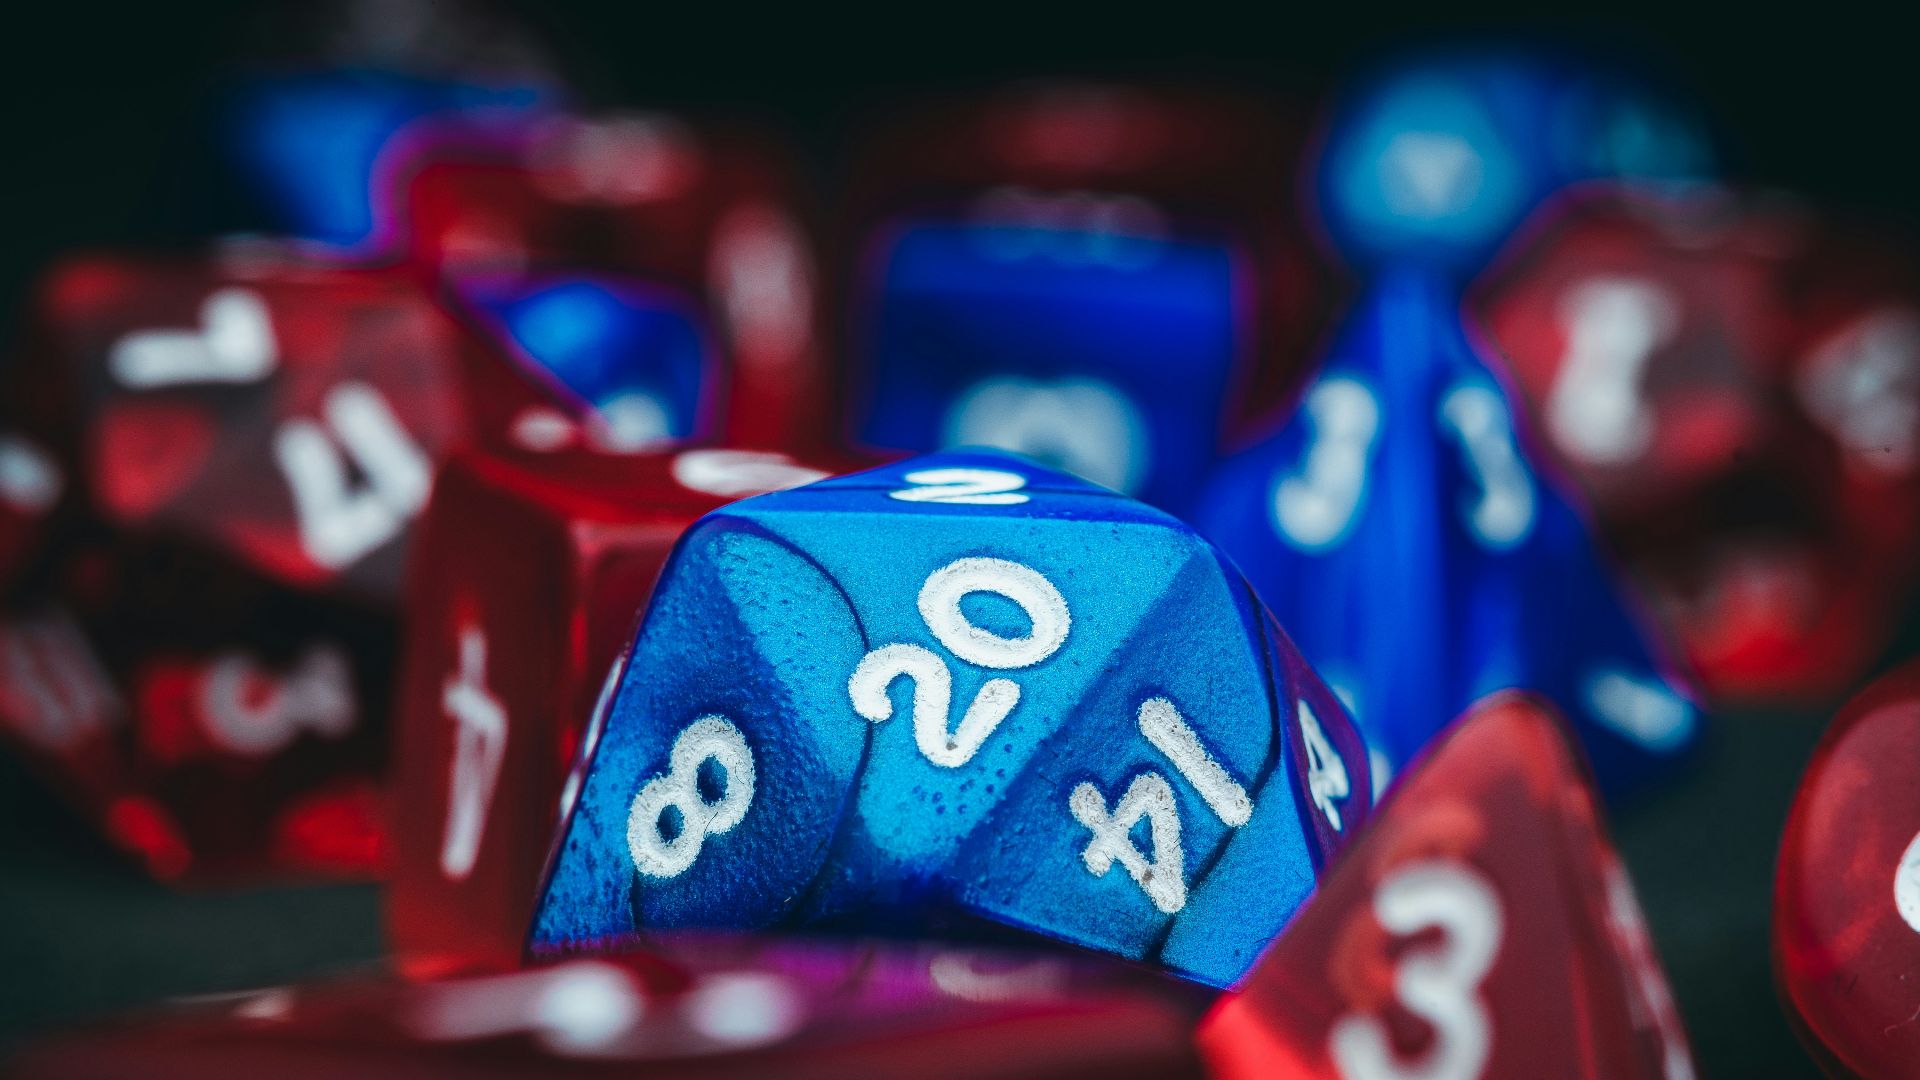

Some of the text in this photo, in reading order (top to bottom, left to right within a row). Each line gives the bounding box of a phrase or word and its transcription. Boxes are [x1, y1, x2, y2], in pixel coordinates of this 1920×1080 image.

[890, 468, 1031, 504] 2
[849, 556, 1072, 768] 20
[628, 713, 756, 879] 8
[1069, 697, 1252, 914] 14
[1299, 699, 1349, 832] 4
[1329, 856, 1503, 1080] 3
